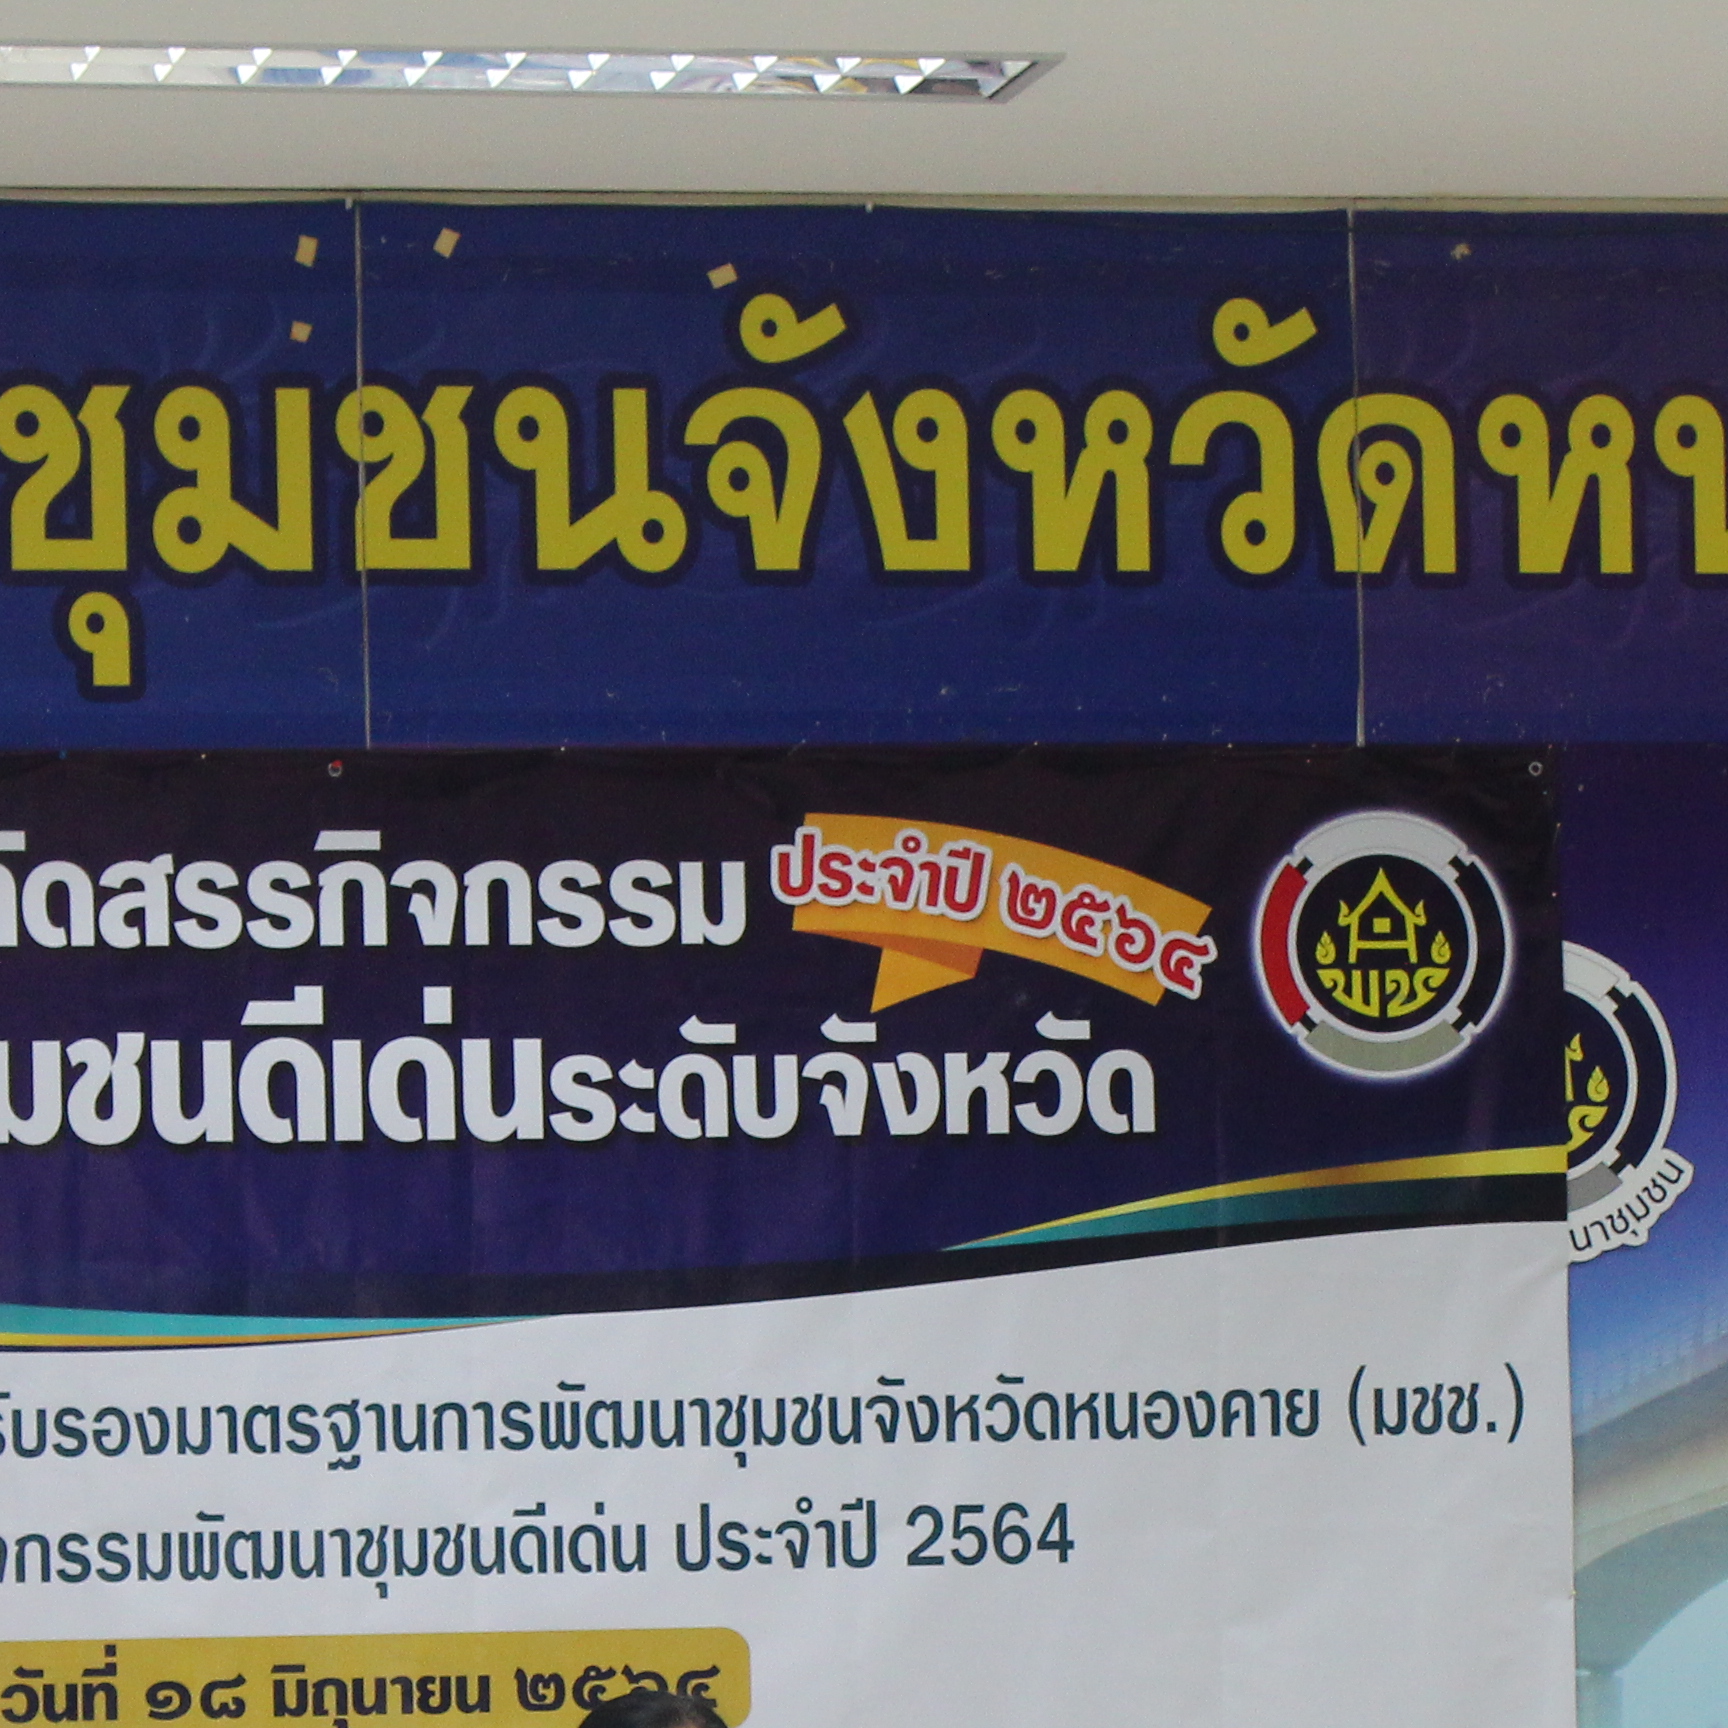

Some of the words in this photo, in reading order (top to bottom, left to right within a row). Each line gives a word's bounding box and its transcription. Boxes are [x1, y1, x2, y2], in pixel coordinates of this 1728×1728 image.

[777, 827, 985, 917] ประจำปี
[1005, 866, 1211, 996] ๒๕๖๔
[1348, 1365, 1529, 1449] (มชช.)
[677, 1495, 875, 1572] ประจำปี
[907, 1503, 1075, 1567] 2564
[0, 1646, 119, 1724] วันที่
[147, 1675, 245, 1720] ๑๘
